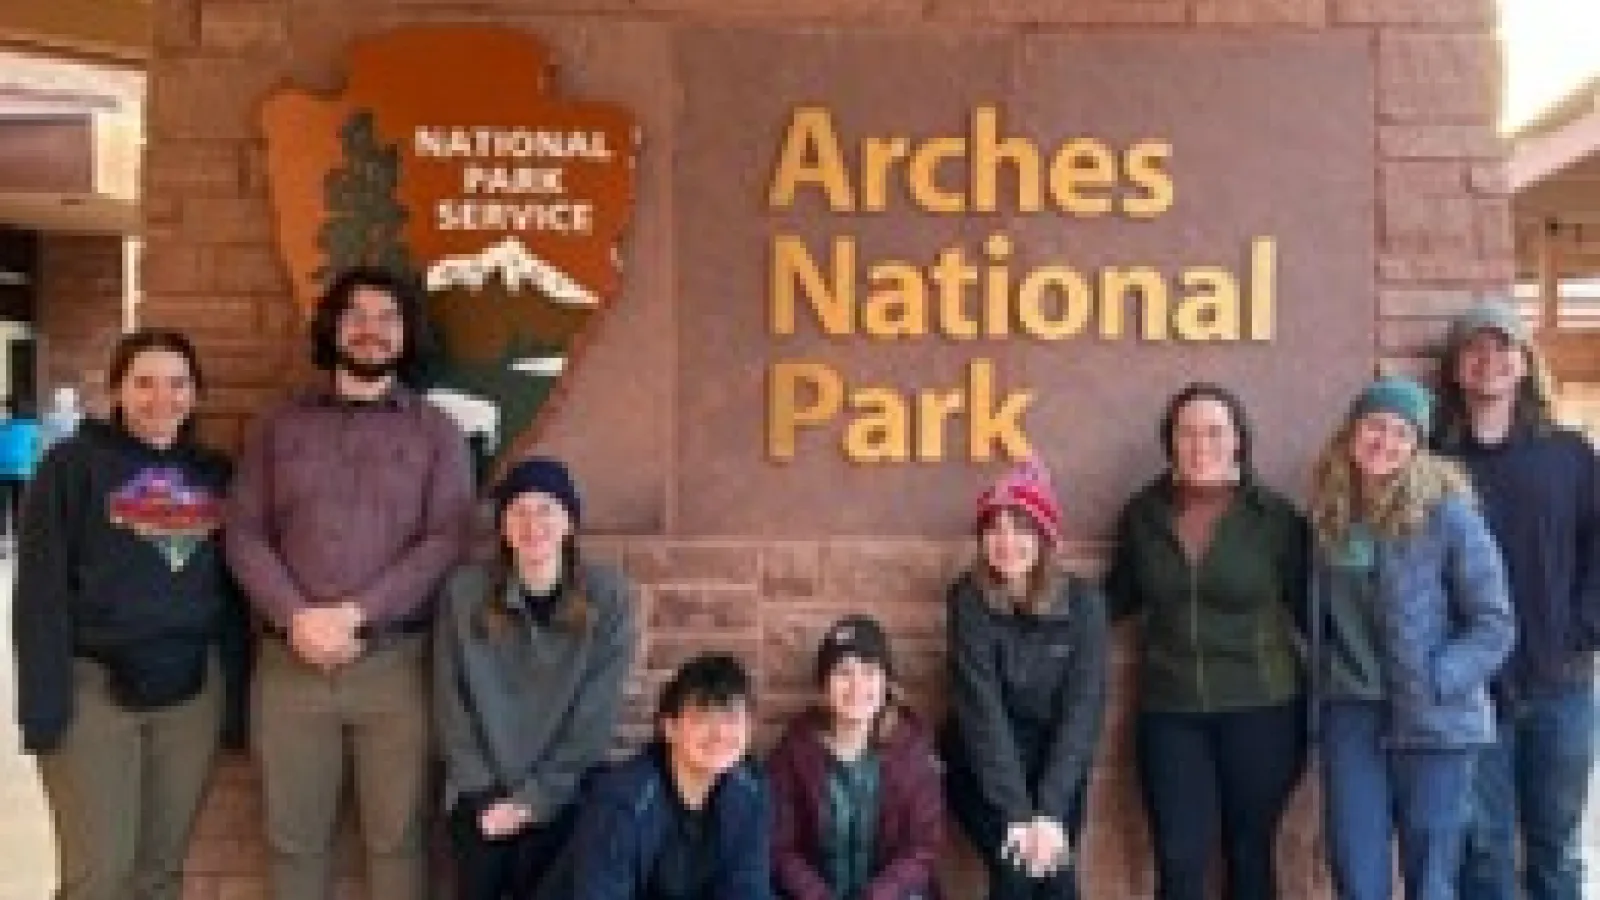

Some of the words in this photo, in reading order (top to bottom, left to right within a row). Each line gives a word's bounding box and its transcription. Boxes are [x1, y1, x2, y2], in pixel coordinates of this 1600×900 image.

[414, 126, 611, 158] NATIONAL
[768, 106, 1174, 213] Arches
[463, 166, 565, 194] PARK
[437, 200, 593, 232] SERVICE
[770, 236, 1277, 340] National
[767, 359, 1034, 462] Park
